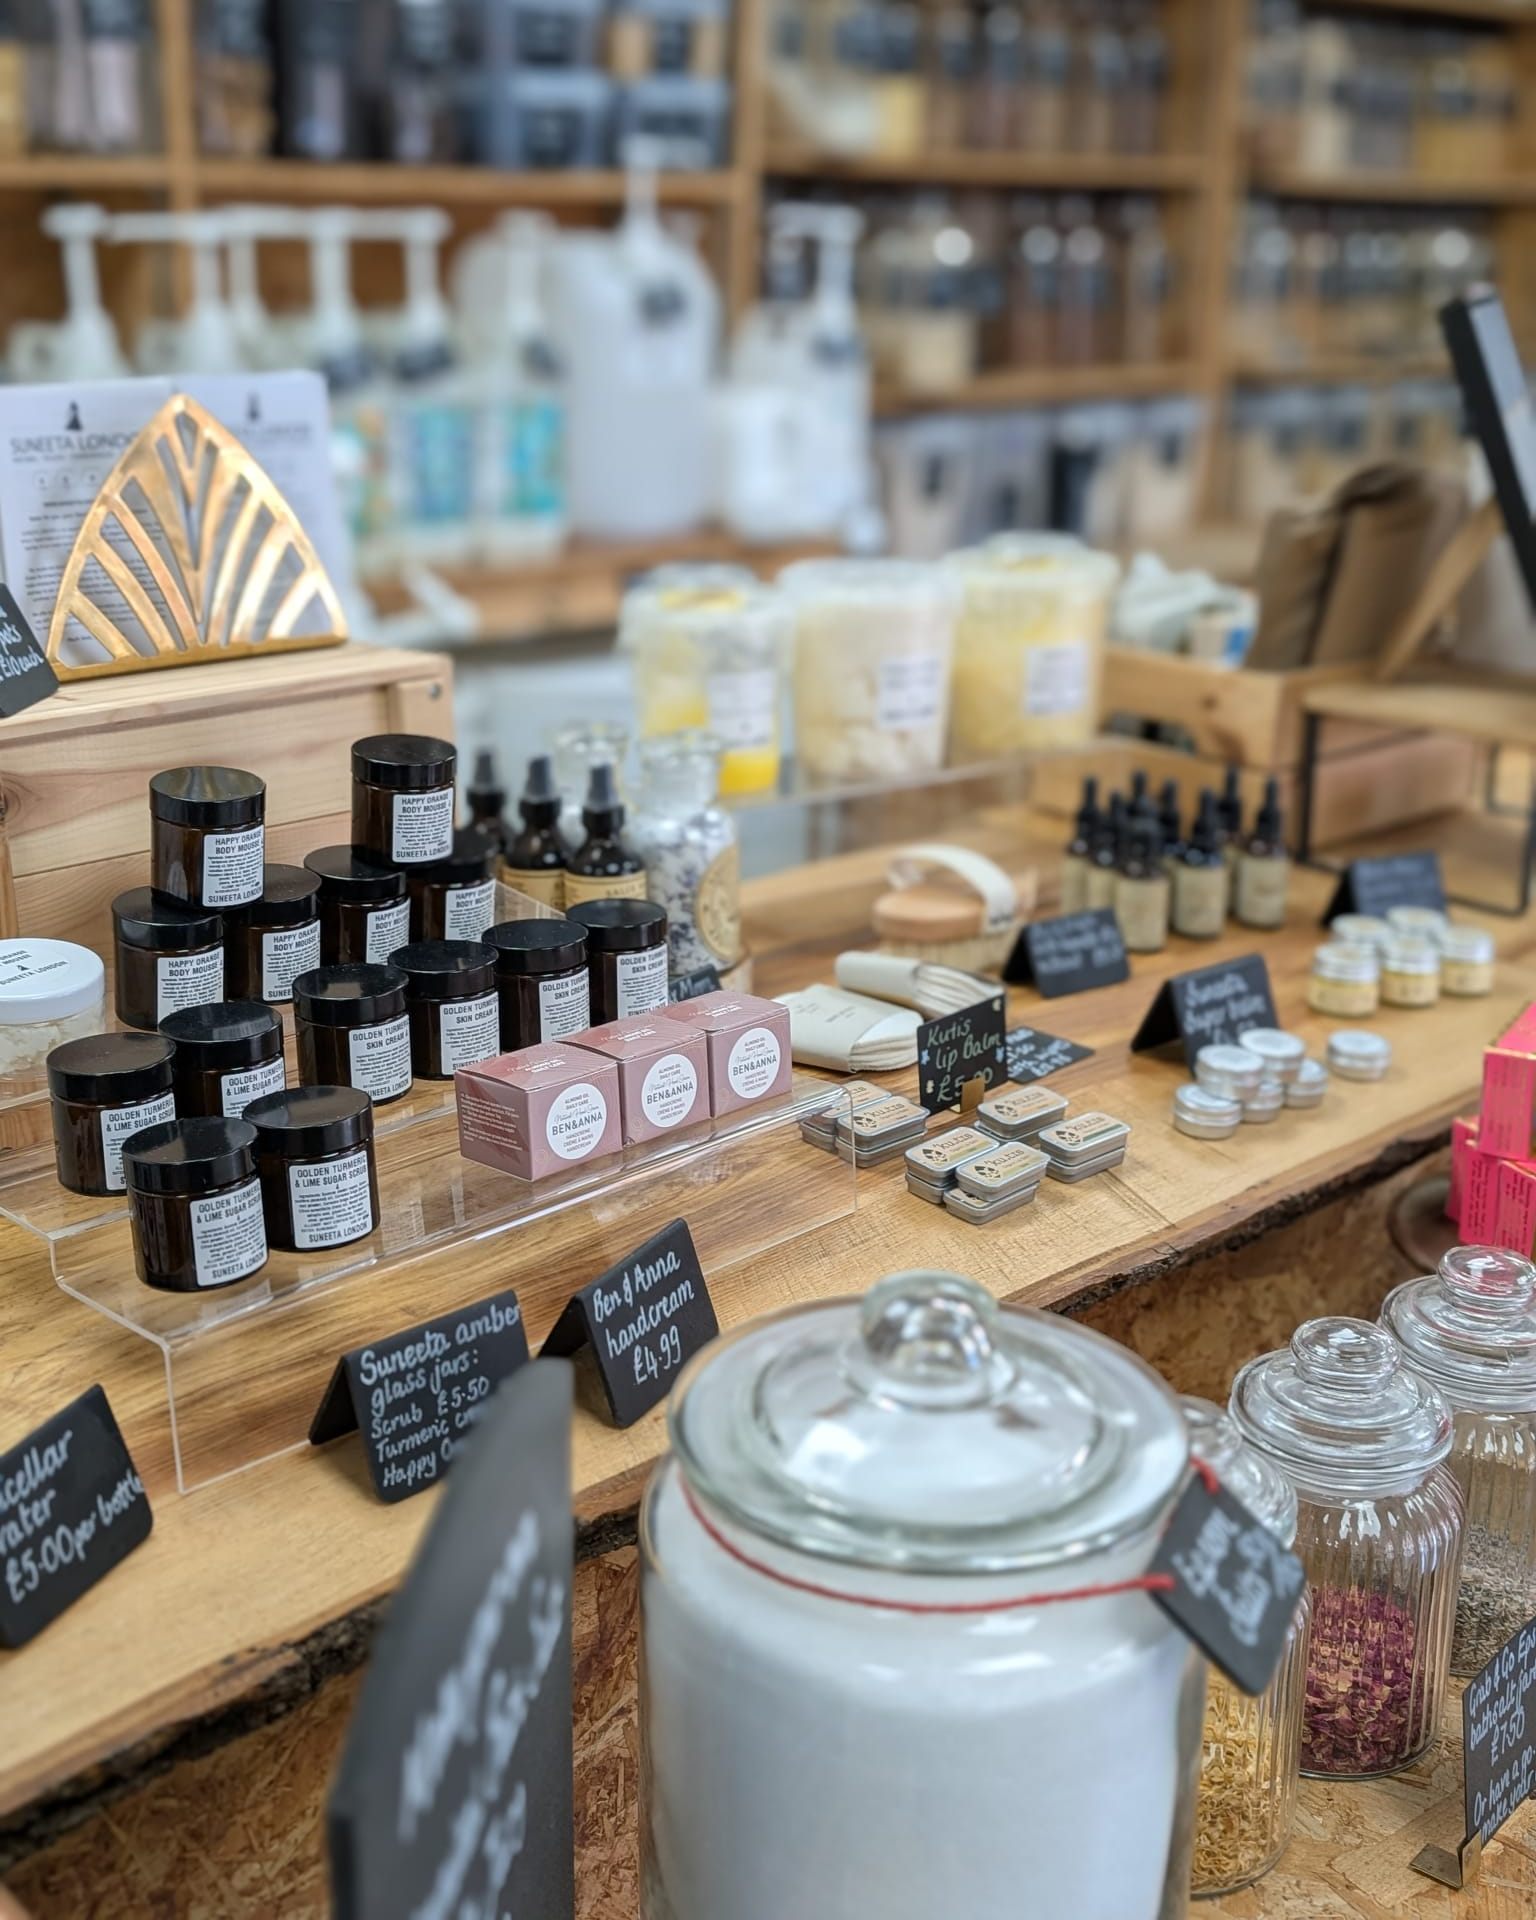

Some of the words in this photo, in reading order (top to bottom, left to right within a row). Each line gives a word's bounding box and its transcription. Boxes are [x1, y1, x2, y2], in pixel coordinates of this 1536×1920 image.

[78, 430, 131, 451] LONDO
[401, 797, 425, 806] HAPPY
[402, 806, 422, 814] BODY
[215, 836, 240, 846] HAPPY
[215, 846, 236, 855] BODY
[396, 850, 428, 858] SUNEETA
[207, 893, 241, 903] SUNEETA
[455, 892, 477, 900] HAPPY
[456, 900, 474, 908] BODY
[375, 912, 395, 922] HAPPY
[375, 921, 392, 930] BODY
[273, 934, 297, 944] HAPPY
[273, 943, 293, 952] BODY
[168, 960, 194, 969] HAPPY
[195, 951, 220, 966] ORANGE
[168, 969, 190, 977] BODY
[192, 961, 218, 974] MOUSSE
[267, 989, 292, 998] SUNEE
[542, 981, 569, 993] GOLDEN
[554, 990, 570, 1000] SKIN
[443, 1005, 473, 1016] GOLDEN
[456, 1014, 473, 1024] SKIN
[474, 1008, 494, 1021] CREAM
[352, 1030, 383, 1042] GOLDEN
[366, 1039, 384, 1050] SKIN
[385, 1032, 405, 1046] CREAM
[935, 1046, 958, 1073] Lip
[963, 1033, 1001, 1060] Balm
[732, 1054, 777, 1077] BEN&ANNA
[226, 1088, 232, 1097] &
[233, 1084, 250, 1096] LIME
[252, 1078, 272, 1091] SUGAR
[228, 1074, 258, 1087] GOLDEN
[367, 1087, 392, 1098] UNEETA
[564, 1095, 583, 1105] ALMOND
[646, 1080, 694, 1105] BEN&ANNA
[106, 1123, 112, 1132] &
[114, 1121, 133, 1132] LIME
[134, 1115, 158, 1129] SUGAR
[108, 1110, 140, 1122] GOLDEN
[552, 1111, 603, 1136] BEN&ANNA
[297, 1166, 330, 1178] GOLDEN
[332, 1154, 366, 1173] TURMERIC
[295, 1180, 300, 1188] &
[302, 1177, 321, 1188] LIME
[322, 1172, 347, 1186] SUGAR
[348, 1164, 367, 1179] SCRUB
[196, 1215, 202, 1224] &
[204, 1209, 222, 1222] LIME
[224, 1202, 247, 1217] SUGAR
[198, 1199, 231, 1213] GOLDEN
[308, 1230, 341, 1243] SUNEETA
[343, 1220, 368, 1237] LONDON
[211, 1262, 244, 1279] SUNEETA
[592, 1287, 622, 1324] Ben
[622, 1270, 634, 1308] &
[633, 1249, 681, 1293] Anna
[359, 1330, 452, 1386] Suneeta
[455, 1303, 521, 1346] amber
[632, 1324, 681, 1385] £4.99
[371, 1367, 427, 1420] glass
[429, 1348, 480, 1395] jars:
[370, 1402, 424, 1440] Scrub
[375, 1417, 450, 1464] Turmeric
[383, 1450, 437, 1487] Happy
[5, 1523, 76, 1604] £5.00
[1469, 1669, 1492, 1719] Grab
[1493, 1656, 1501, 1692] &
[1501, 1645, 1515, 1680] Go
[1474, 1791, 1487, 1827] Or
[1489, 1768, 1511, 1811] have
[1511, 1759, 1520, 1780] a
